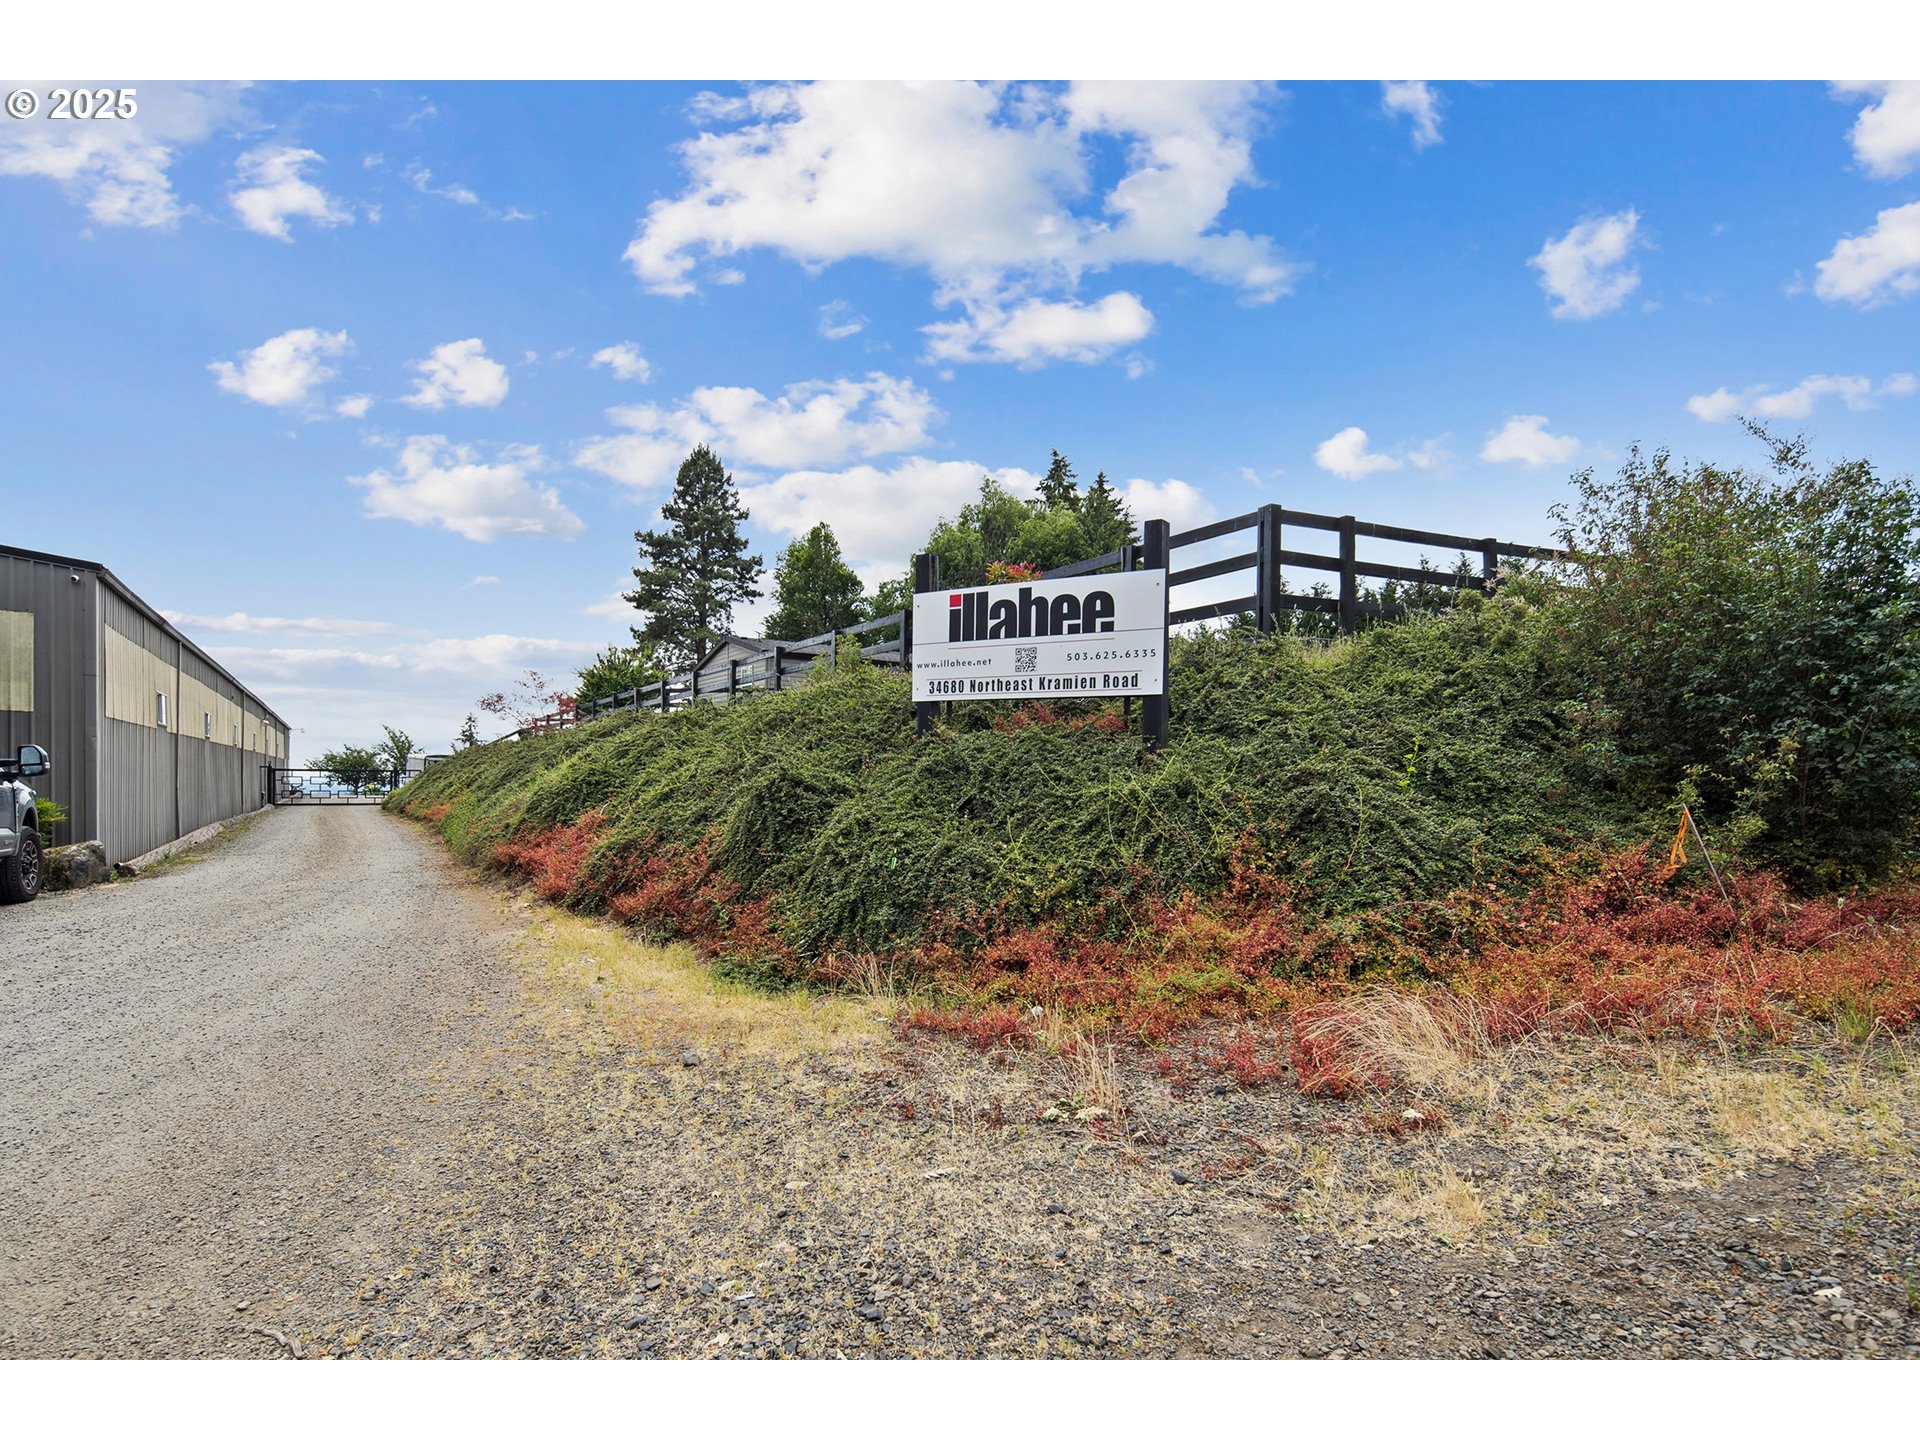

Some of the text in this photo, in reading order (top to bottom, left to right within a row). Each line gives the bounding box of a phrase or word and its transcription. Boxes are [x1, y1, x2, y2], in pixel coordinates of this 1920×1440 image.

[949, 587, 1115, 642] illahee
[1066, 649, 1157, 661] 503.625.6335
[917, 658, 992, 669] www.illahee.net
[929, 673, 1139, 694] 34680 Northeast Kramien Road
